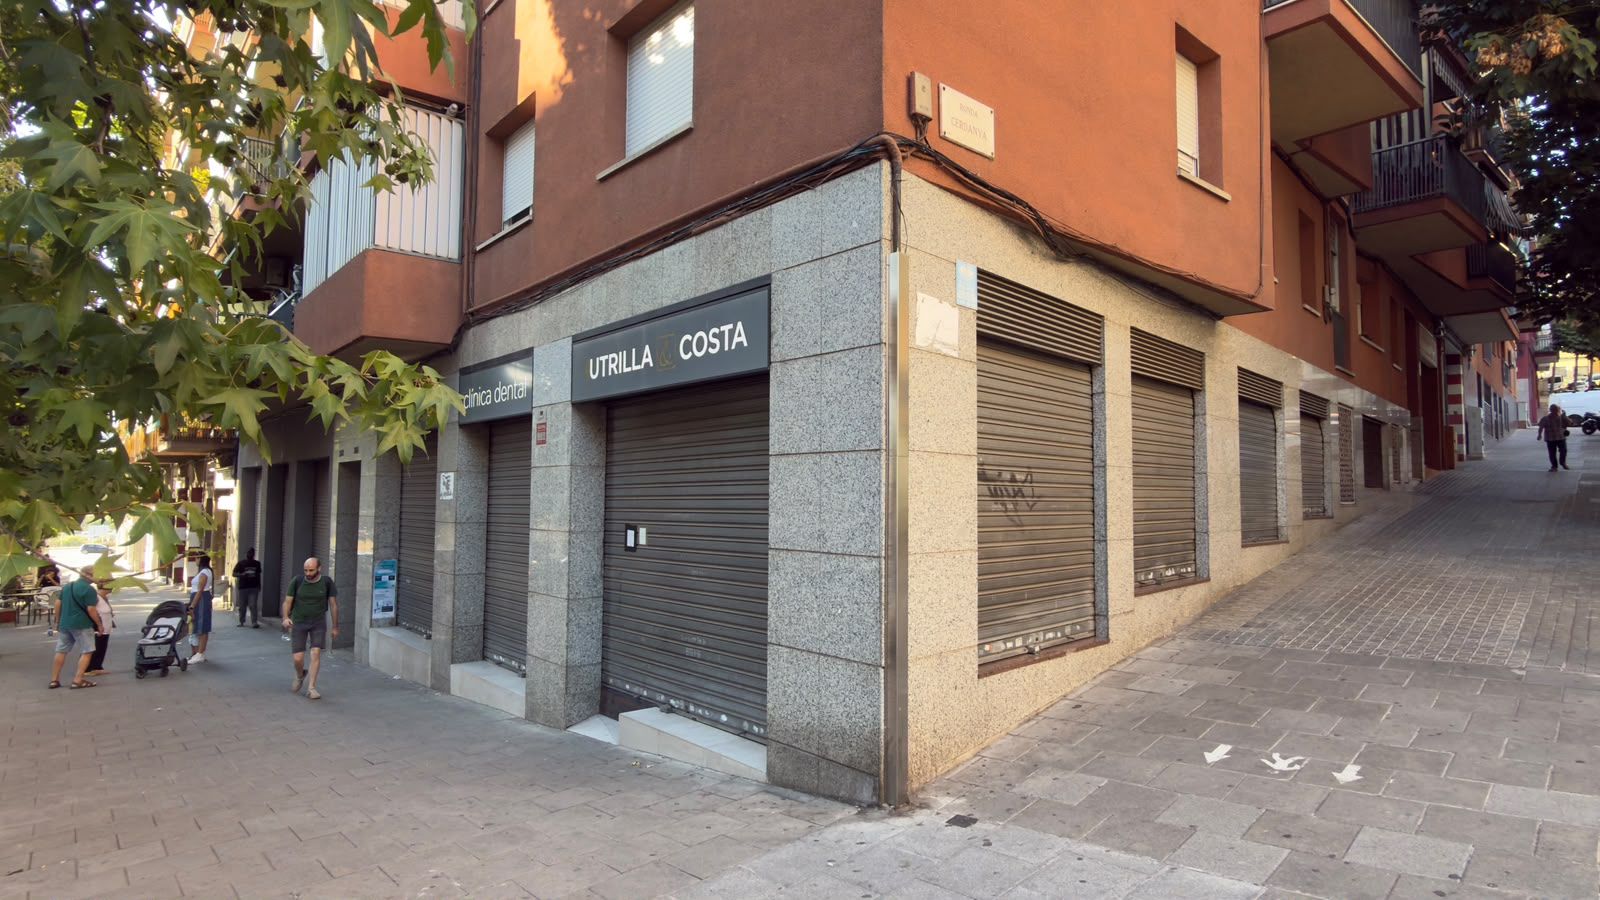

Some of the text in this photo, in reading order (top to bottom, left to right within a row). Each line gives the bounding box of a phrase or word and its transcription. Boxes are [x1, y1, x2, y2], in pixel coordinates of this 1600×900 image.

[951, 117, 987, 140] CERDANYA
[589, 344, 654, 380] UTRILLA
[679, 320, 748, 361] COSTA
[463, 376, 527, 409] clínica dental
